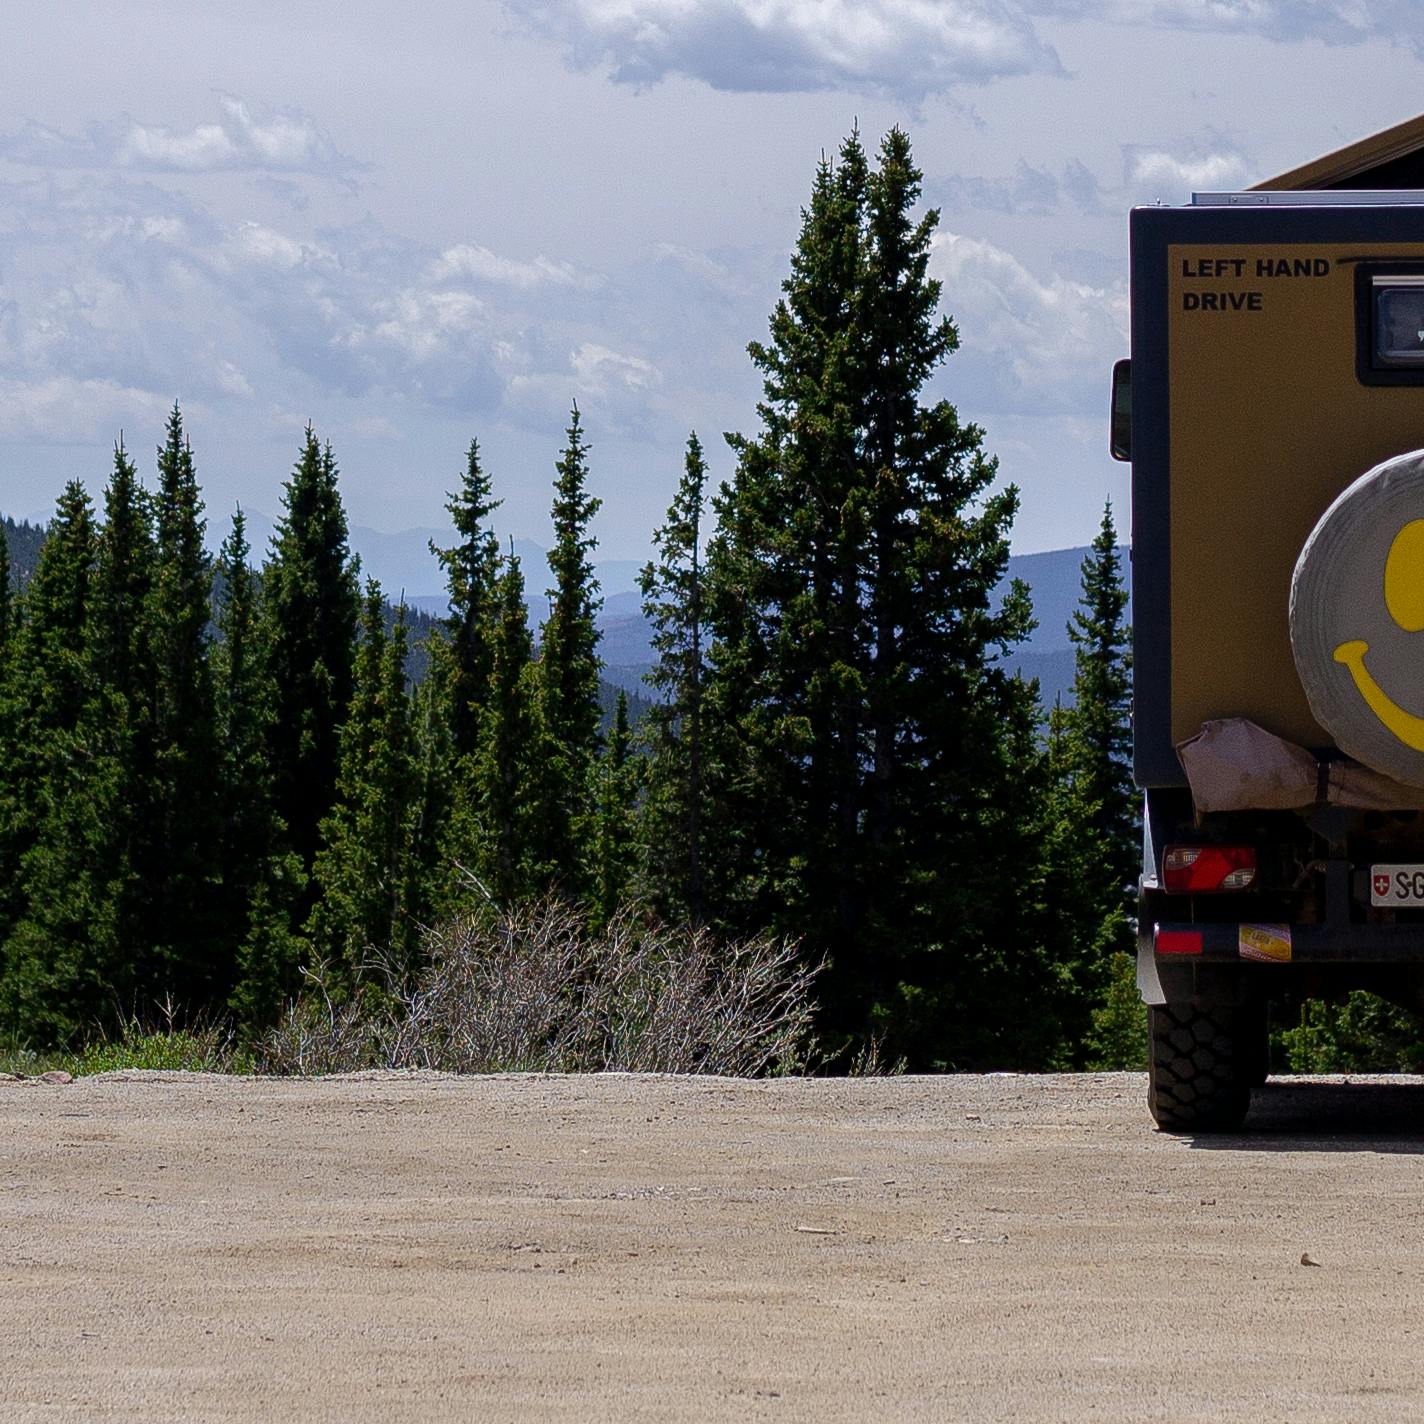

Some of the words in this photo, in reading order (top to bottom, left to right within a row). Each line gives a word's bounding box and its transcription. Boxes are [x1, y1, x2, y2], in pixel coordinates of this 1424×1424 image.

[1182, 258, 1247, 277] LEFT
[1256, 258, 1330, 277] HAND
[1182, 291, 1263, 311] DRIVE
